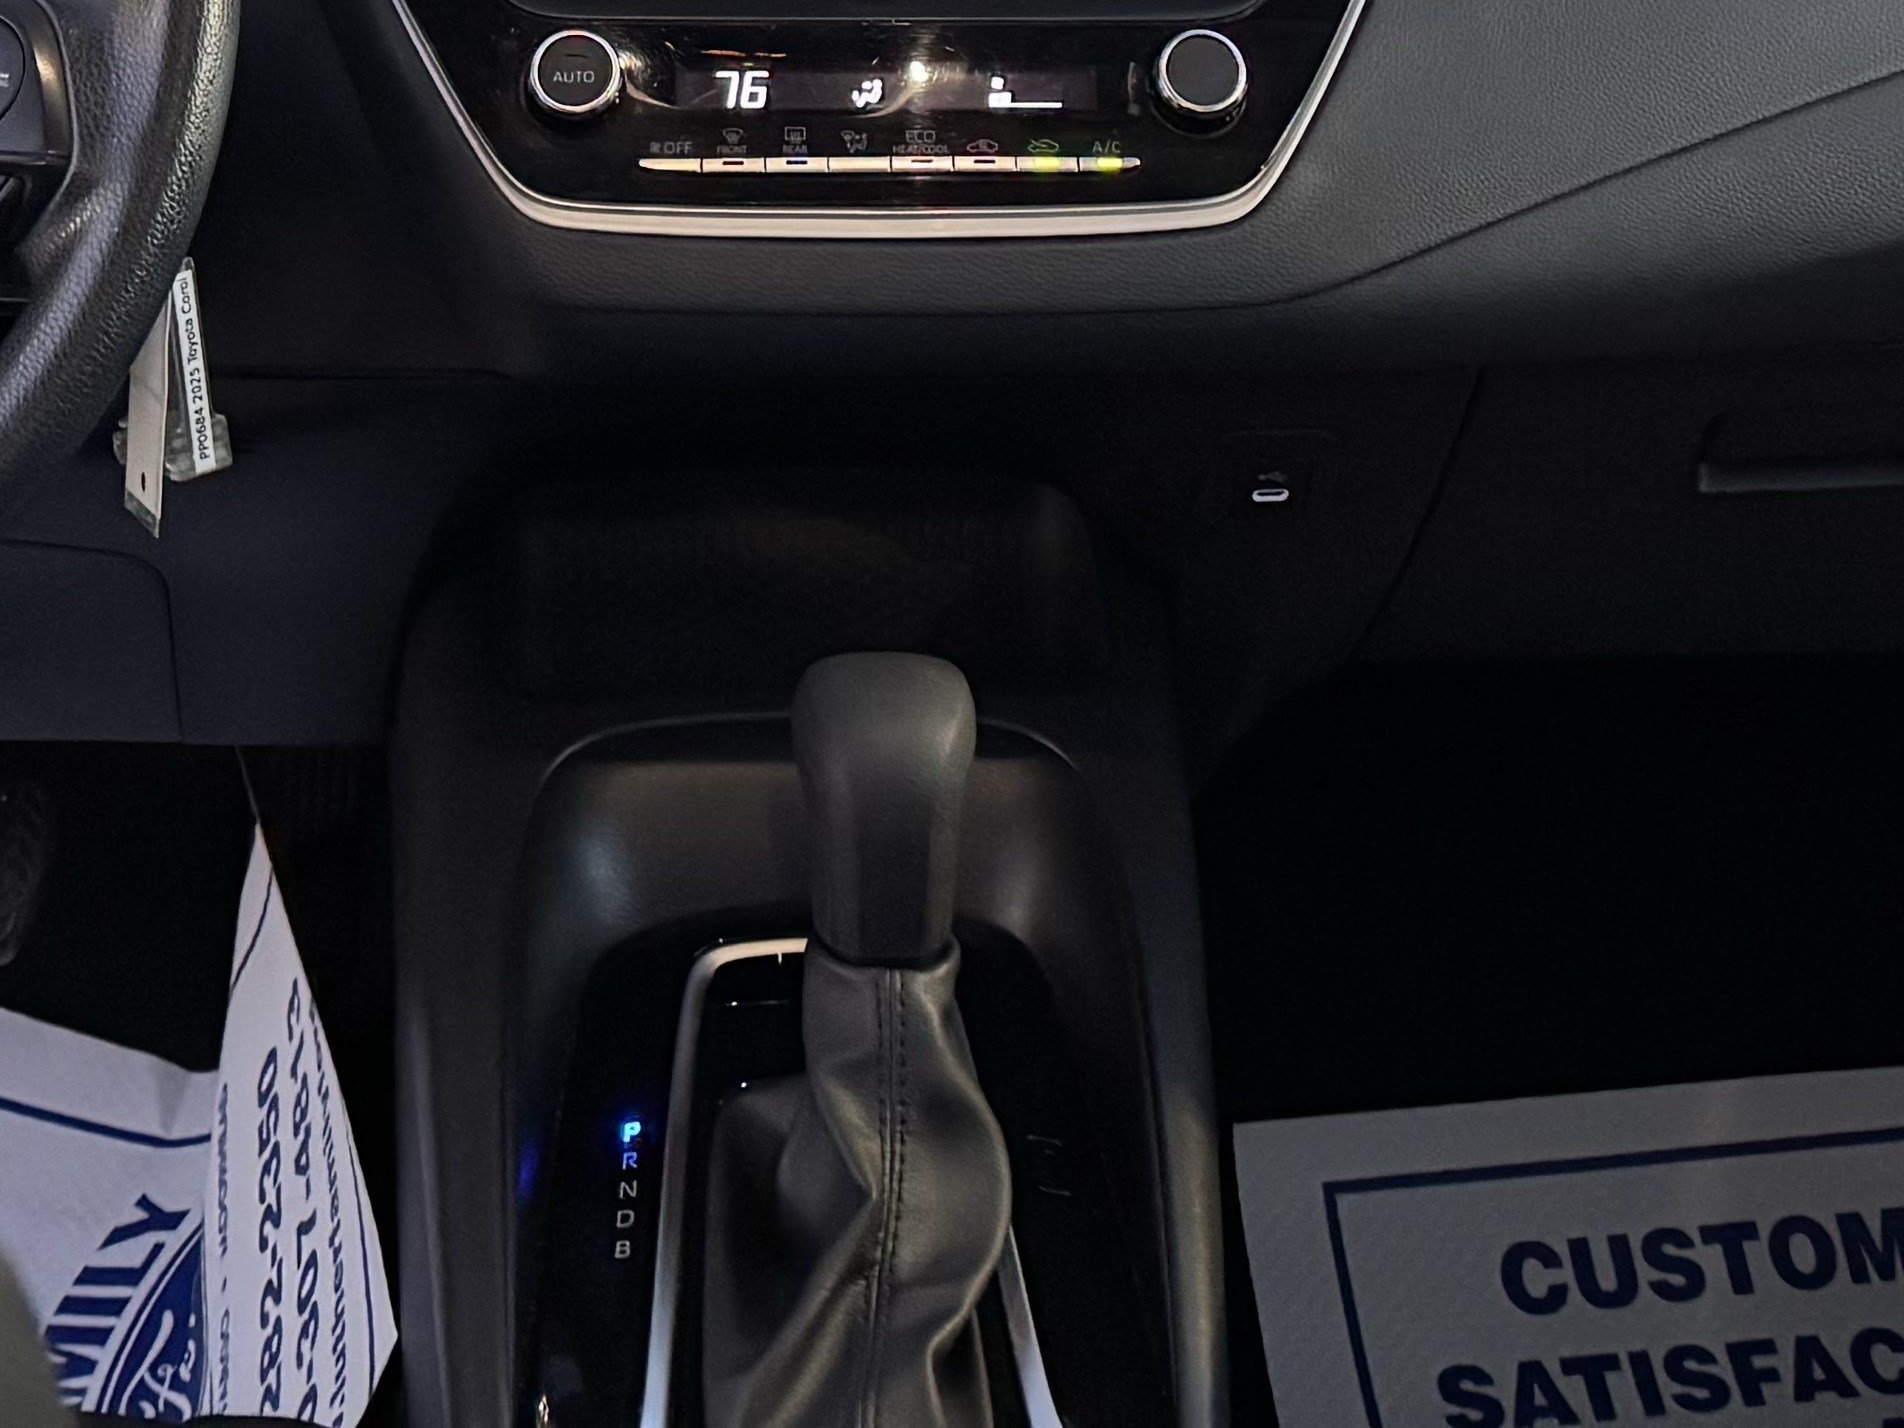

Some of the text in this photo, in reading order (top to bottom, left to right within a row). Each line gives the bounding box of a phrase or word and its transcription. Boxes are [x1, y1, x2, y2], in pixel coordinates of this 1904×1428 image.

[552, 70, 595, 83] AUTO
[714, 70, 770, 110] 76
[905, 130, 936, 143] ECO
[663, 142, 693, 154] OFF
[892, 144, 949, 155] HEAT/COOL
[1092, 141, 1121, 153] A/C
[184, 317, 200, 364] Toyota
[188, 367, 203, 404] 2025
[192, 408, 212, 460] PP0684
[623, 1121, 641, 1143] P
[622, 1151, 638, 1170] R
[619, 1180, 637, 1199] N
[616, 1209, 635, 1228] D
[258, 1046, 284, 1414] 282-2350
[614, 1240, 631, 1259] B
